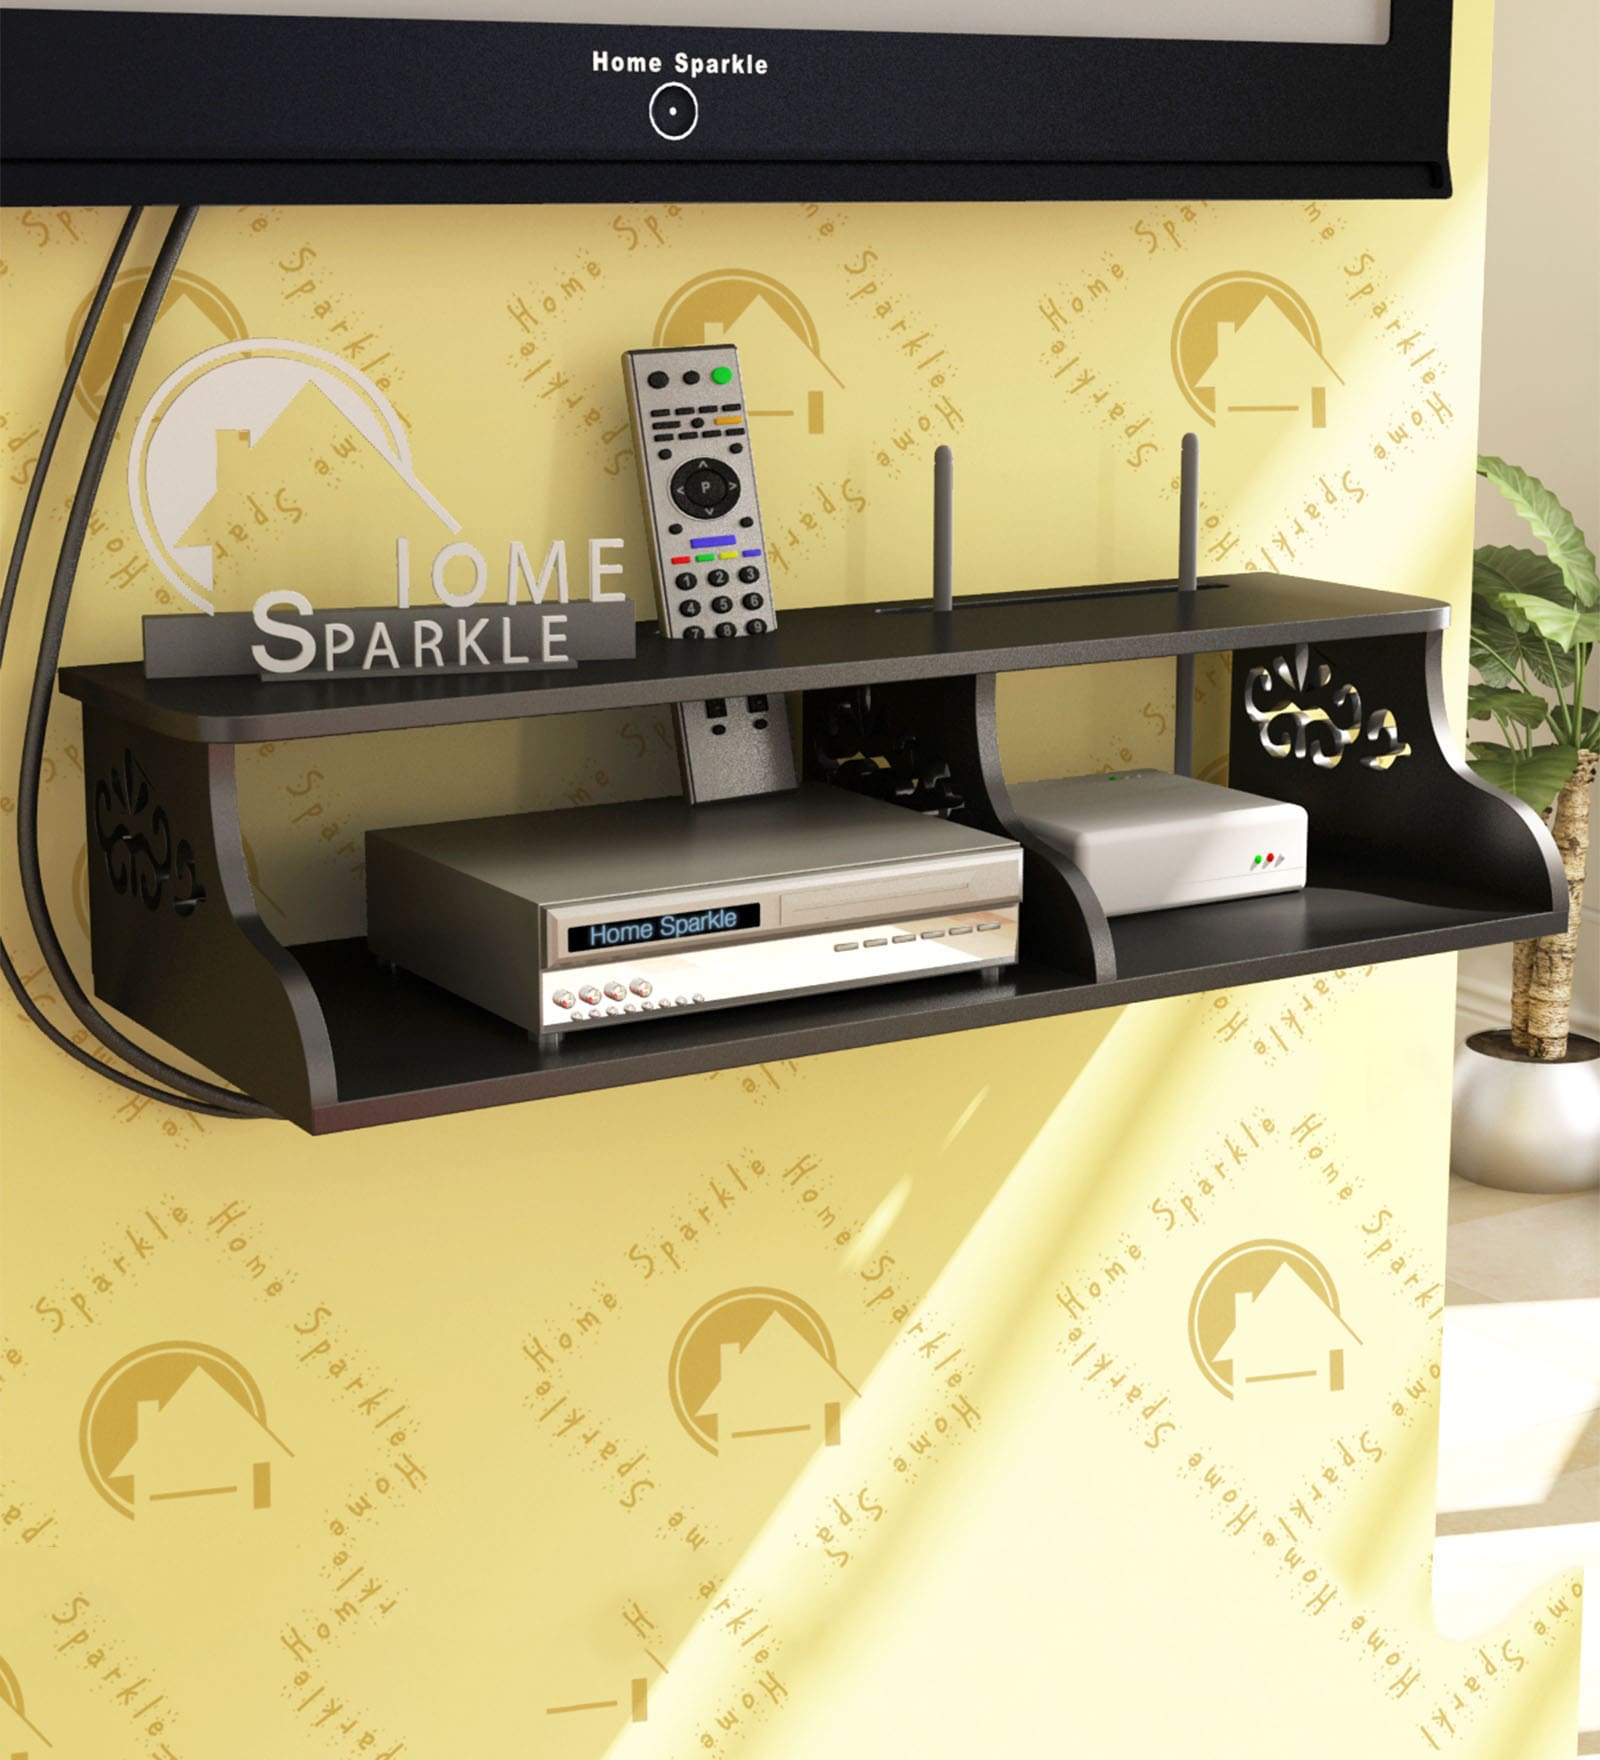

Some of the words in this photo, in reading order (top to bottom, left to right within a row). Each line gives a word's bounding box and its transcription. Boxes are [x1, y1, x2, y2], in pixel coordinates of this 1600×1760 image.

[592, 50, 662, 72] Home
[674, 52, 768, 78] Sparkle
[506, 258, 602, 334] Home
[843, 249, 946, 389] Sparkle
[1039, 261, 1125, 332] Home
[1343, 252, 1438, 385] Sparkle
[875, 395, 965, 470] Home
[1050, 339, 1159, 472] Sparkle
[1373, 392, 1454, 461] Home
[701, 481, 711, 494] P
[768, 478, 867, 572] Spark
[686, 602, 696, 614] 4
[719, 599, 729, 611] 5
[750, 596, 759, 608] 6
[715, 571, 724, 584] 2
[746, 569, 755, 580] 3
[589, 920, 654, 947] Home
[659, 908, 738, 938] Sparkle
[1056, 1243, 1142, 1320] Home
[1151, 1115, 1276, 1232] Sparkle
[1290, 1112, 1355, 1201] Home
[1361, 1208, 1444, 1332] Sparkl
[35, 1202, 189, 1334] Sparkle
[207, 1200, 285, 1298] Home
[521, 1290, 618, 1373] Home
[627, 1157, 766, 1279] Sparkle
[782, 1153, 852, 1247] Home
[860, 1254, 963, 1389] Sparkle
[293, 1305, 408, 1447] Sparkle
[1067, 1325, 1176, 1452] Sparkle
[1391, 1361, 1441, 1418] ome
[533, 1377, 655, 1509] Sparkle
[892, 1394, 982, 1473] Home
[328, 1453, 428, 1537] Home
[1186, 1450, 1258, 1537] Home
[1262, 1431, 1383, 1548] Sparkle
[1533, 1582, 1583, 1637] ome
[51, 1596, 165, 1738] Sparkle
[1350, 1614, 1421, 1700] Home
[700, 1670, 789, 1750] Home
